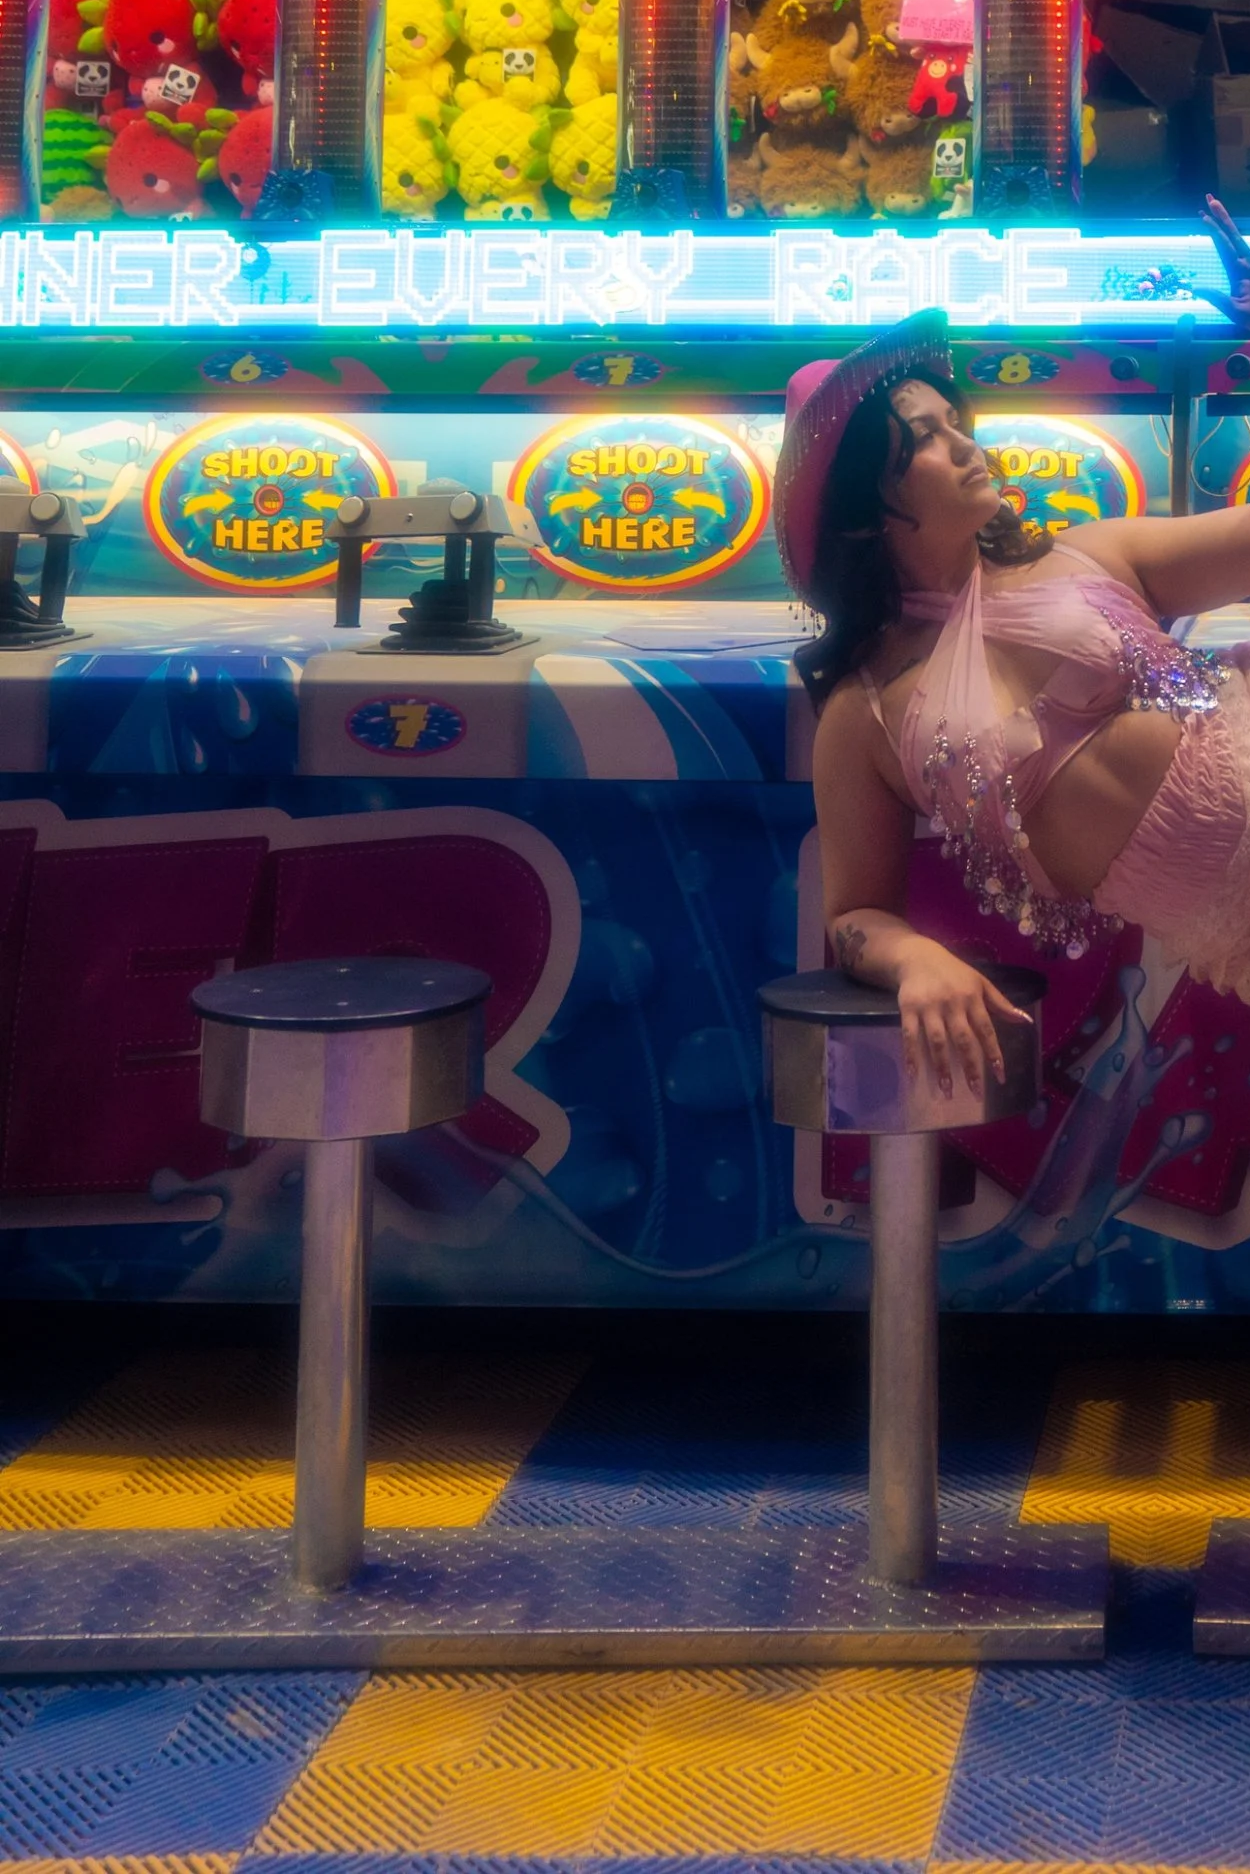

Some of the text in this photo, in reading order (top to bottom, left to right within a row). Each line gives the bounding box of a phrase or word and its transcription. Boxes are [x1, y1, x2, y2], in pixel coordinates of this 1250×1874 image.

[318, 229, 694, 326] EVERY
[771, 229, 1081, 325] RACE
[231, 352, 262, 383] 6
[603, 356, 634, 385] 7
[998, 354, 1031, 384] 8
[202, 446, 340, 479] SHOOT
[569, 444, 711, 477] SHOOT
[213, 518, 325, 553] HERE
[581, 517, 696, 551] HERE
[390, 704, 428, 748] 7
